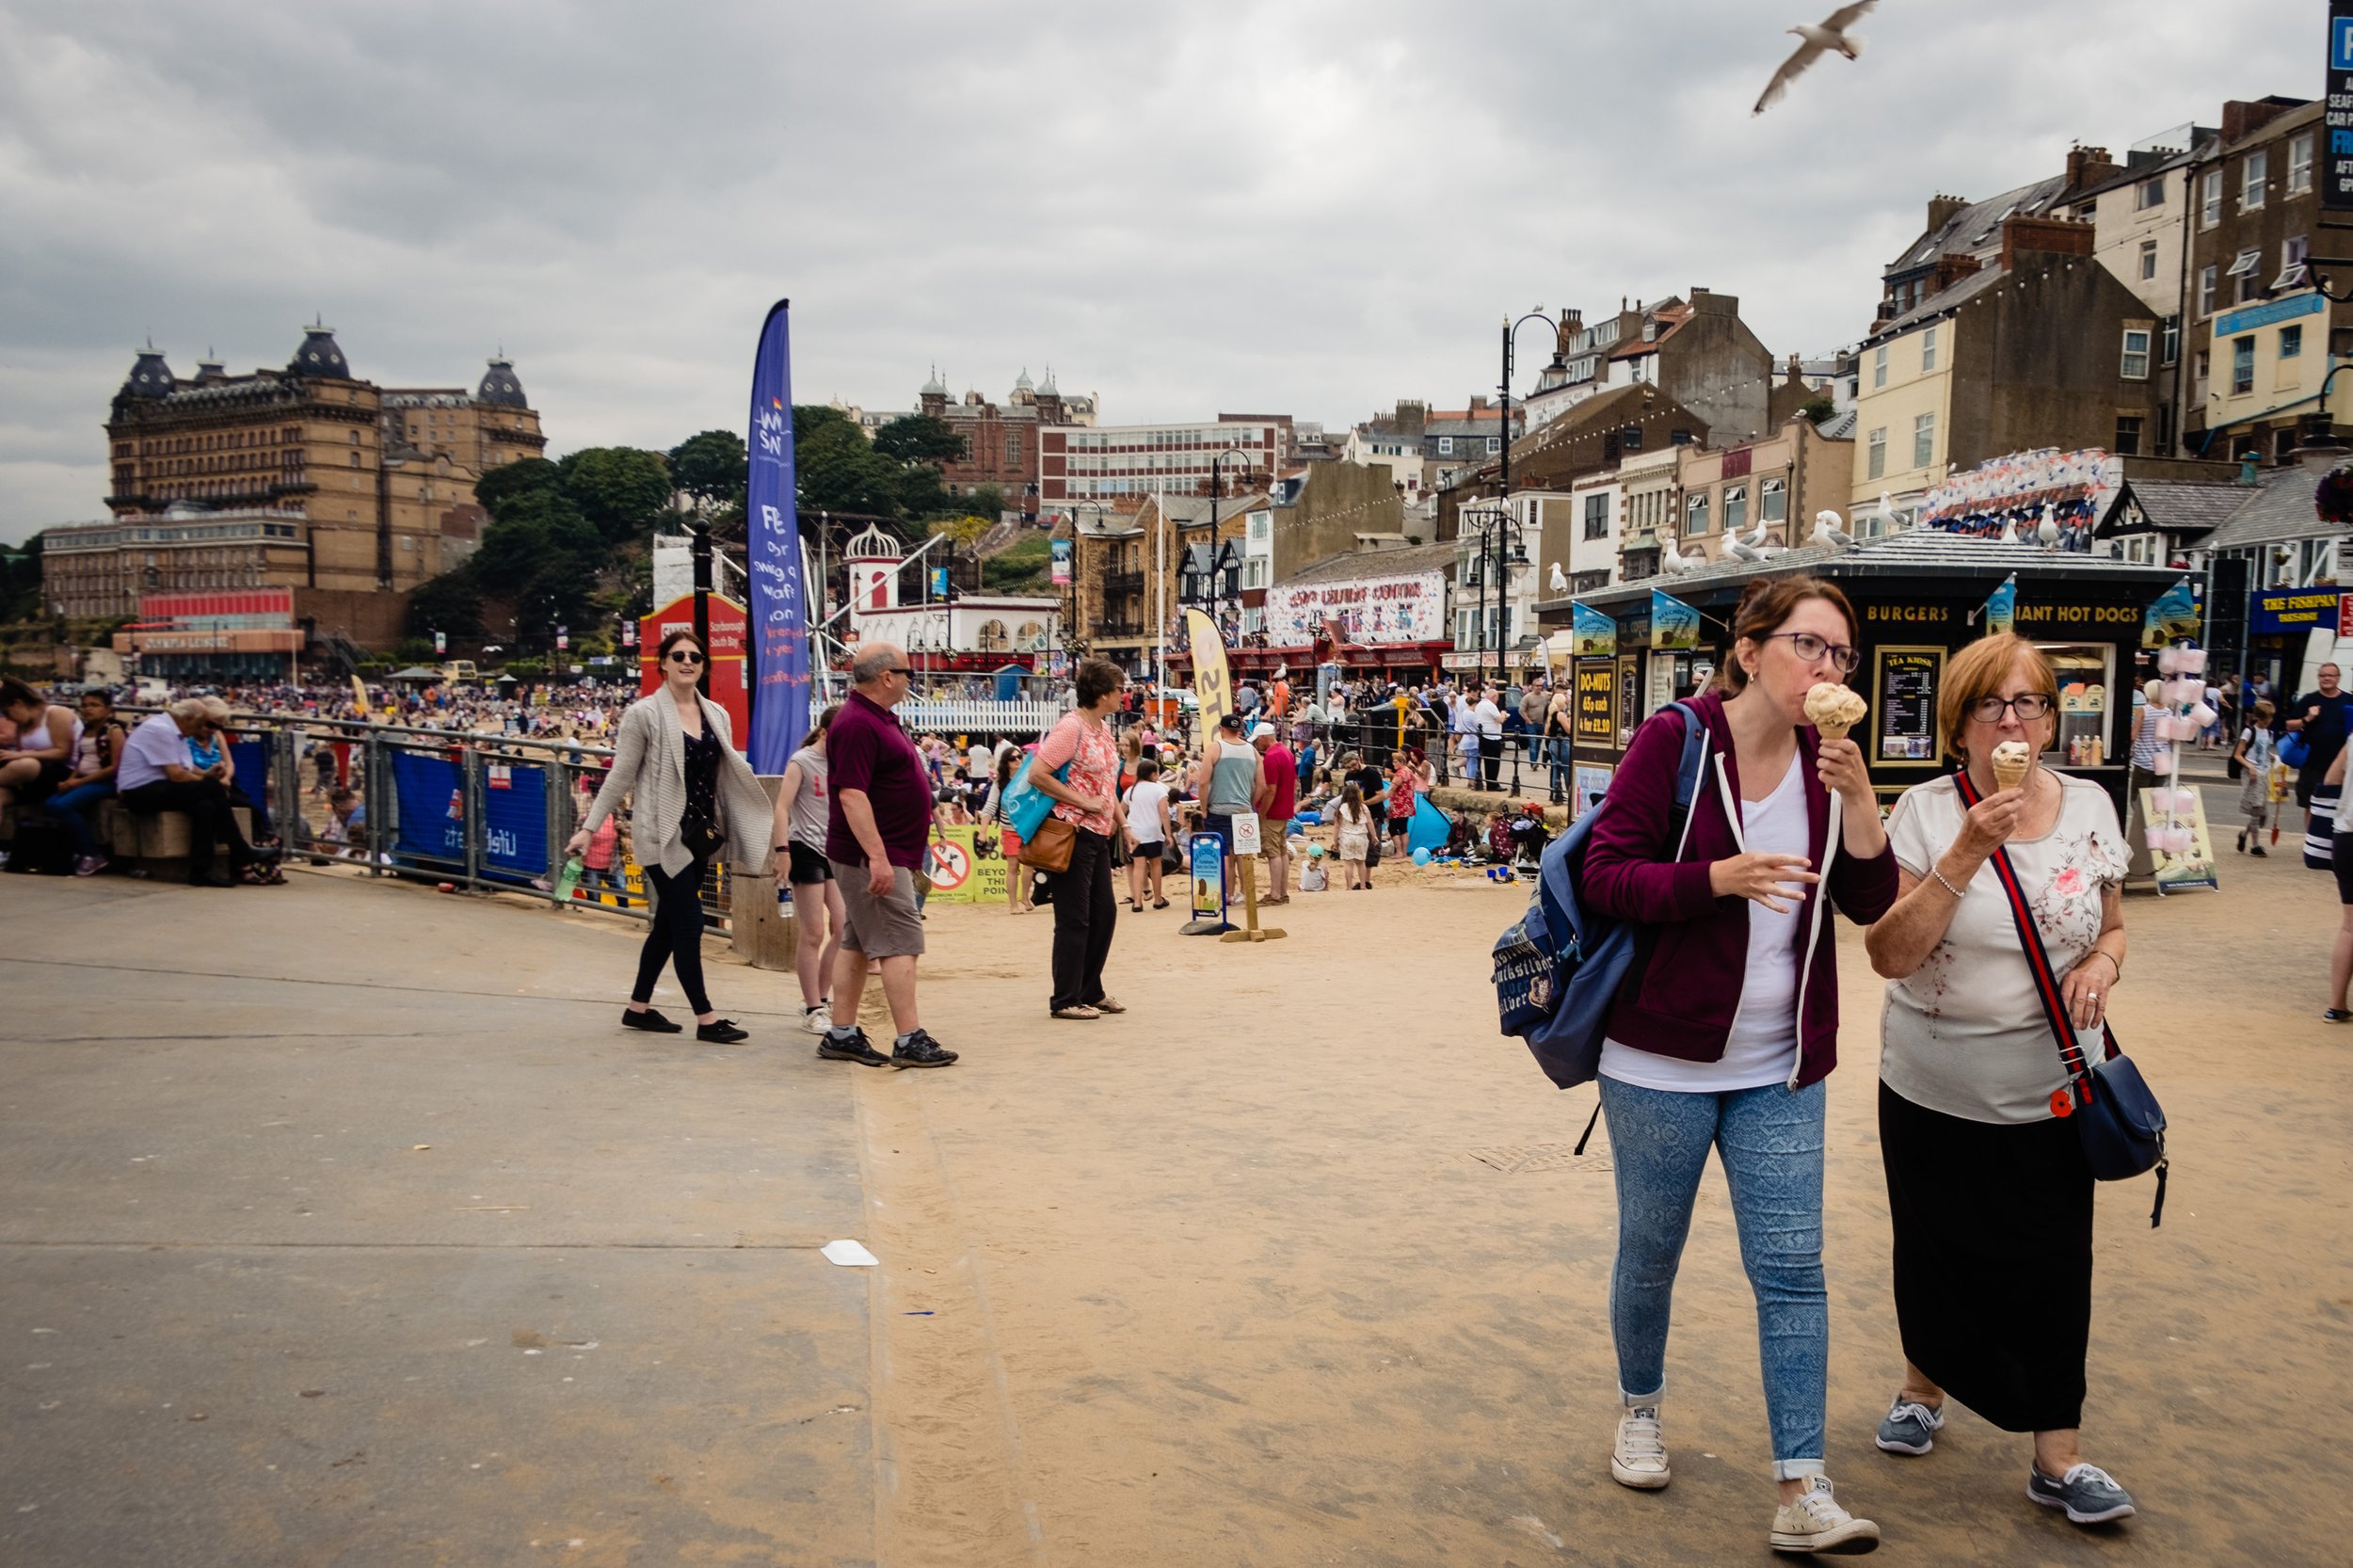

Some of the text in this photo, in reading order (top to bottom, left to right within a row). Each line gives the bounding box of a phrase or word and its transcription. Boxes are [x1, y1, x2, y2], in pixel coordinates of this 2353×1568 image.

[2327, 111, 2346, 126] CAR
[2263, 598, 2286, 611] THE
[1866, 605, 1948, 621] BURGERS
[2015, 605, 2053, 621] IANT
[2057, 606, 2091, 622] HOT
[2094, 606, 2138, 623] DOGS
[710, 636, 740, 649] South Bay
[1887, 656, 1932, 667] TEA KIOSK
[1580, 672, 1611, 692] DO-NUTS
[1582, 696, 1608, 713] 65p each
[1584, 717, 1593, 732] for
